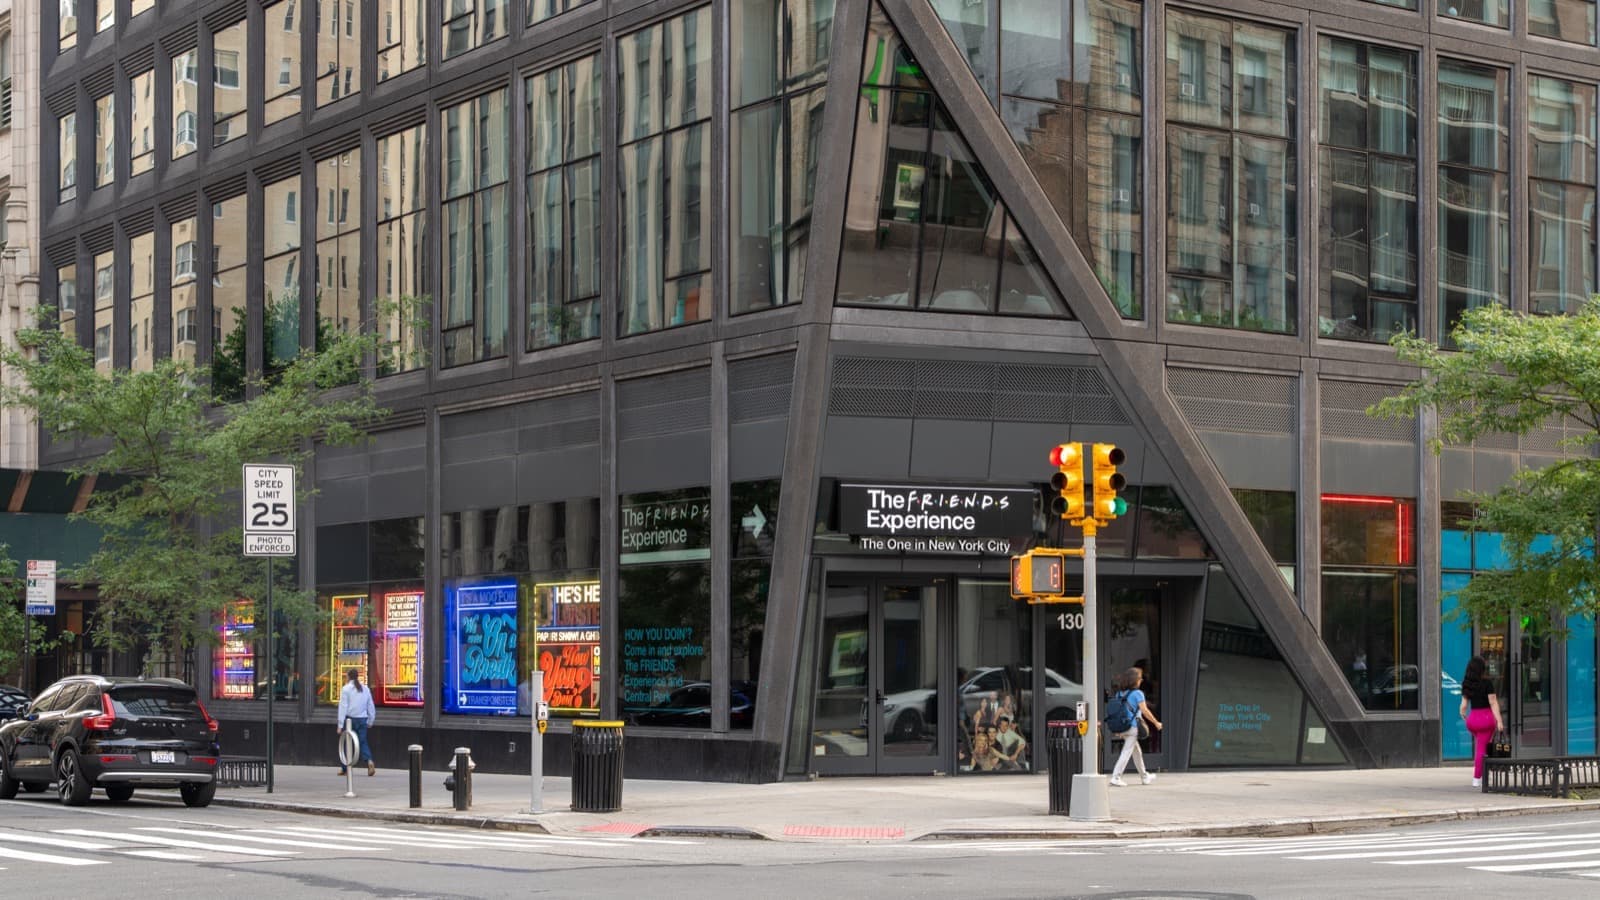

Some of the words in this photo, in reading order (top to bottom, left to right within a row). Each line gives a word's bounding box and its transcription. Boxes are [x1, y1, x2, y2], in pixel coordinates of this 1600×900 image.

[258, 470, 279, 478] CITY
[254, 480, 283, 489] SPEED
[257, 491, 280, 499] LIMIT
[867, 490, 905, 509] The
[252, 502, 288, 527] 25
[622, 508, 644, 527] The
[866, 509, 976, 534] Experience
[257, 536, 283, 544] PHOTO
[621, 526, 688, 551] Experience
[249, 544, 291, 552] ENFORCED
[861, 538, 884, 550] The
[887, 539, 911, 550] One
[915, 538, 926, 550] in
[928, 540, 955, 551] New
[958, 539, 984, 552] York
[987, 540, 1011, 554] City
[556, 585, 582, 604] HE'S
[1057, 613, 1084, 630] 130
[624, 629, 644, 640] HOW
[645, 628, 662, 640] YOU
[624, 644, 647, 656] Come
[648, 645, 656, 655] in
[657, 644, 672, 656] and
[673, 644, 704, 658] explore
[624, 660, 638, 672] The
[640, 659, 675, 671] FRIENDS
[400, 664, 417, 683] BAG
[624, 674, 666, 688] Experience
[667, 675, 683, 687] and
[624, 690, 652, 703] Central
[653, 690, 671, 702] Park
